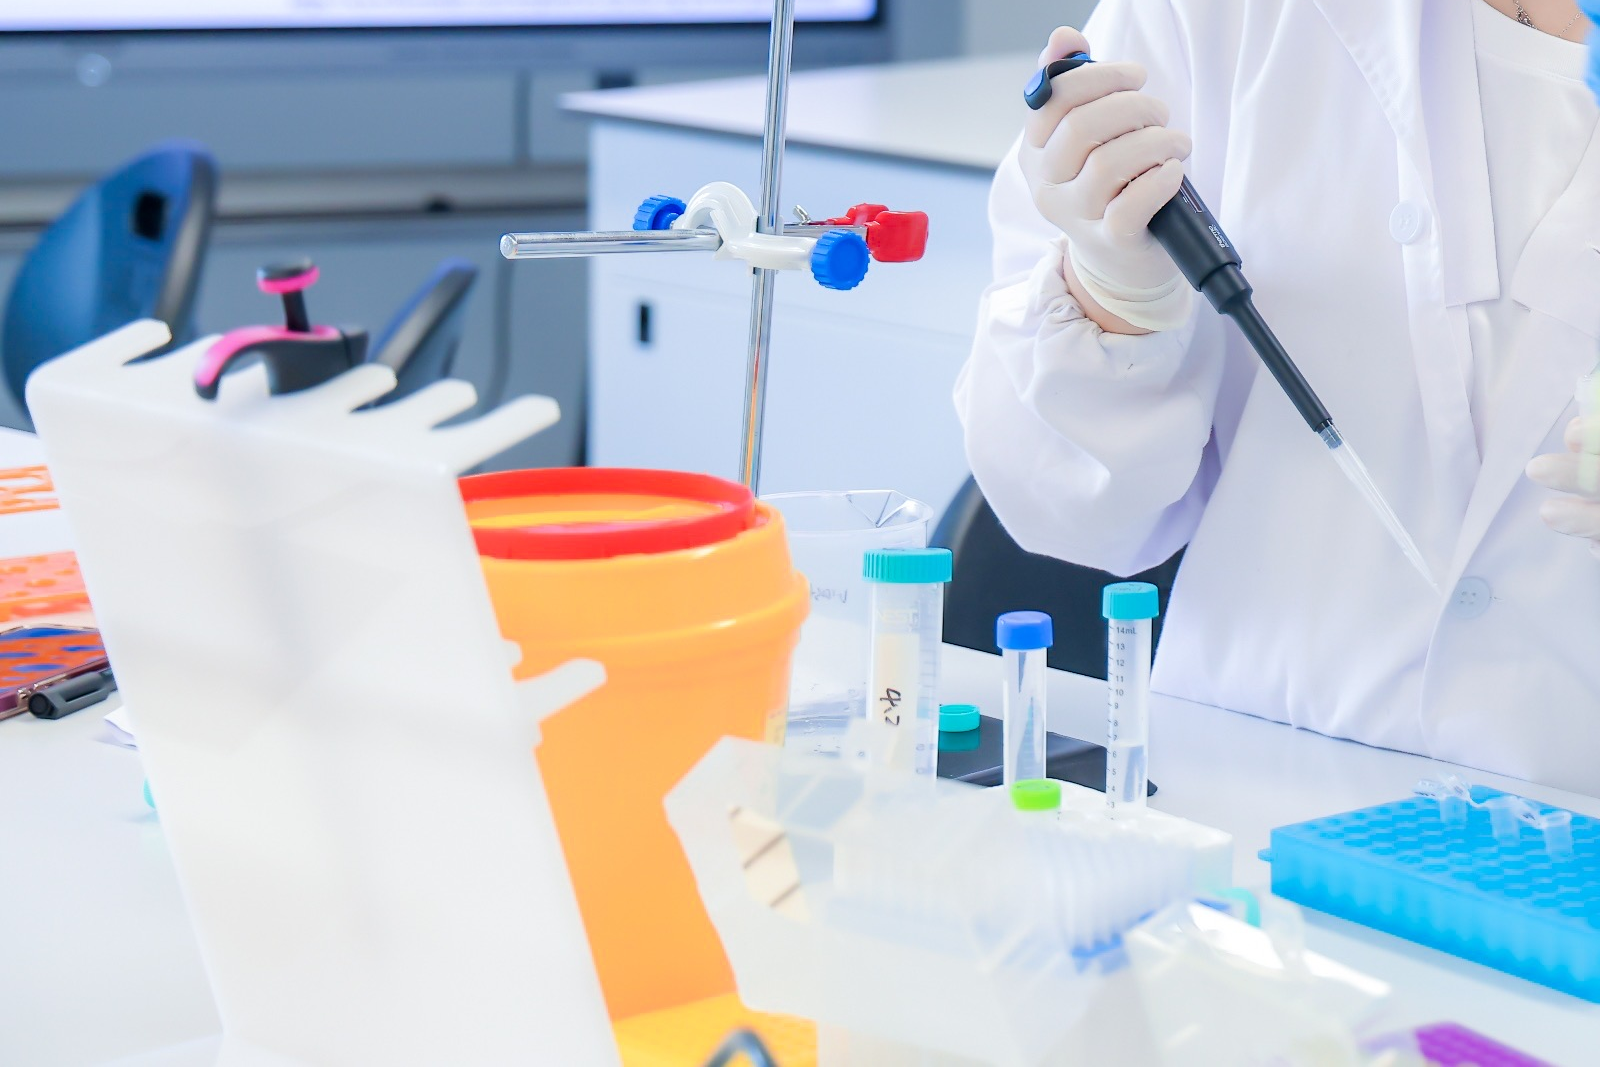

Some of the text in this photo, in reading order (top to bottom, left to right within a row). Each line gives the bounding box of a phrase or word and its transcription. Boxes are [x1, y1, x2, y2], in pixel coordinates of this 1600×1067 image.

[1116, 627, 1137, 635] 14mL
[1116, 643, 1125, 651] 13
[1116, 659, 1125, 667] 12
[1115, 675, 1124, 683] 11
[1115, 689, 1124, 697] 10
